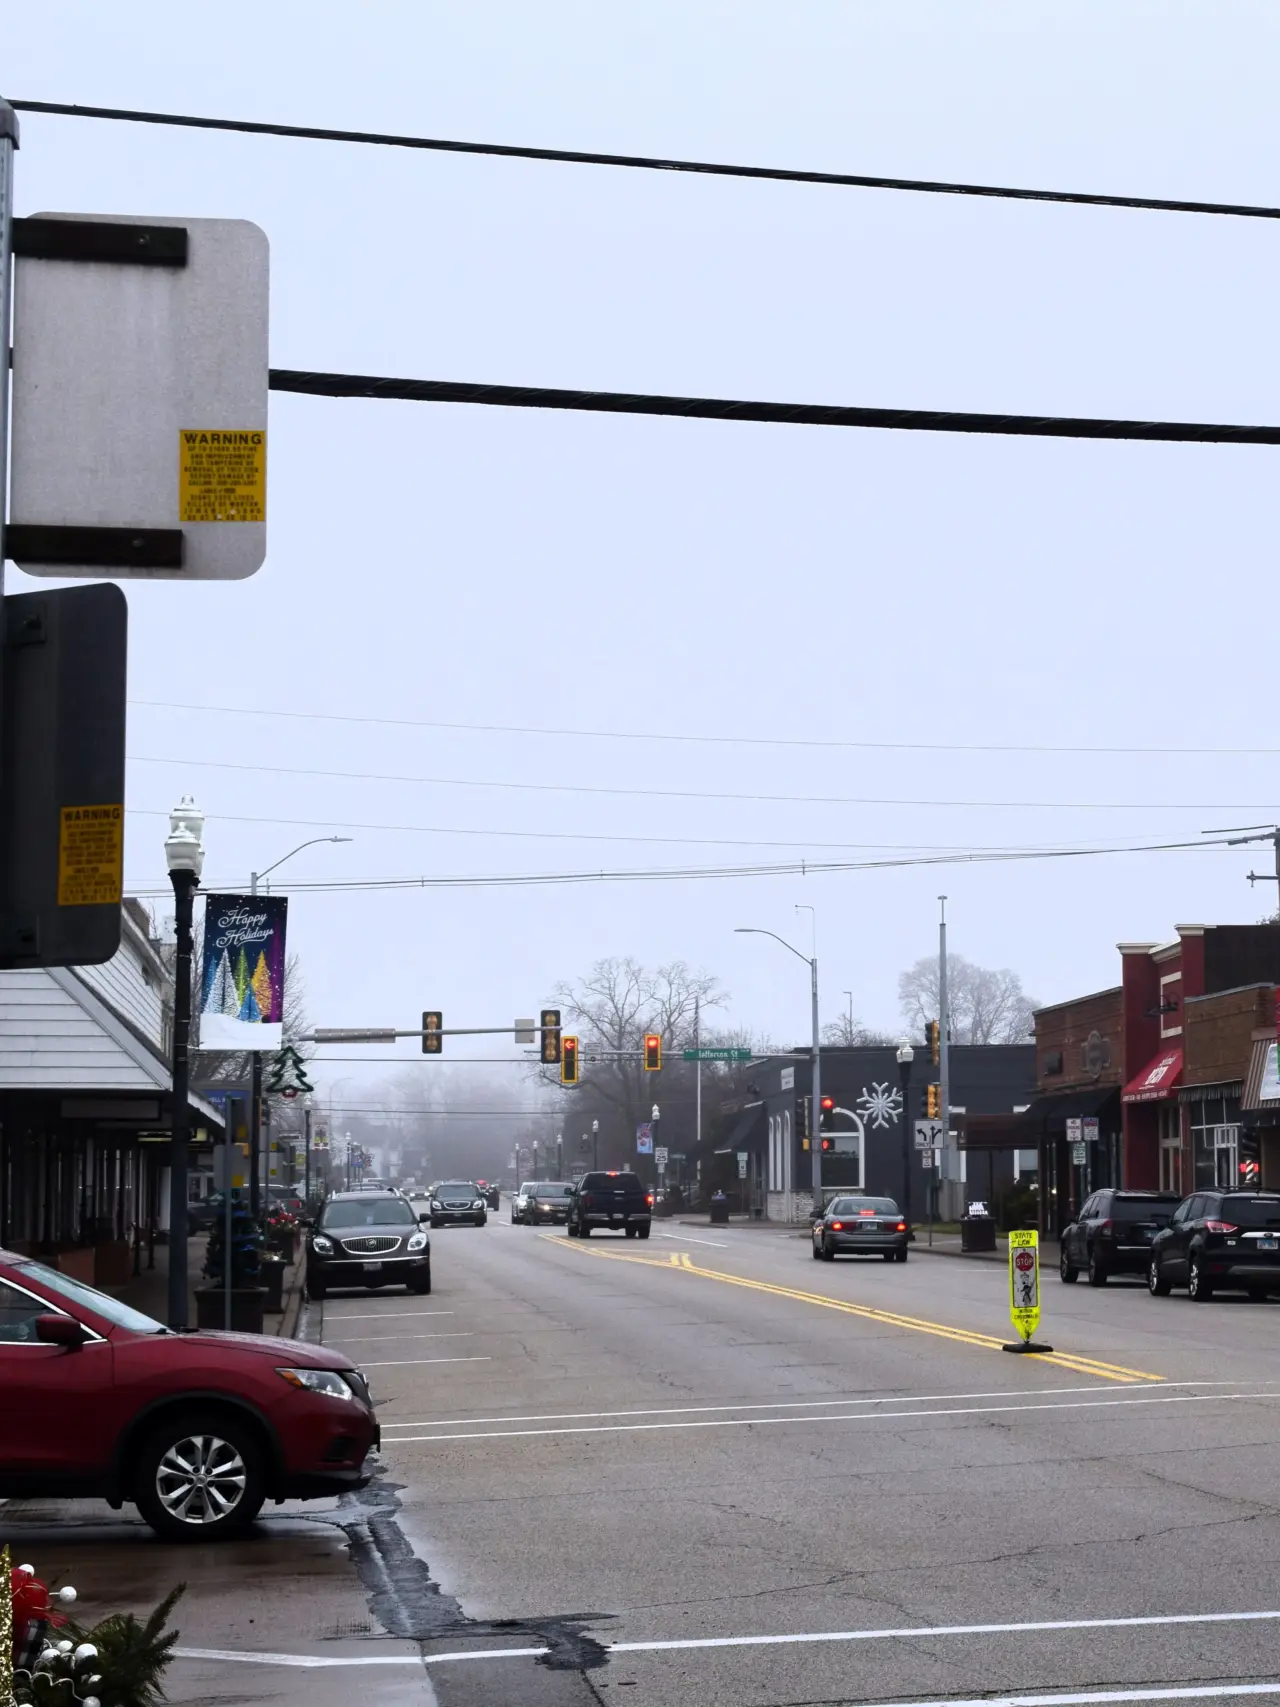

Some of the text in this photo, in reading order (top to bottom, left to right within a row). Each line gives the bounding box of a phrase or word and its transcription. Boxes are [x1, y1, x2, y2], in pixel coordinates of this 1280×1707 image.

[184, 433, 262, 445] WARNING
[64, 807, 120, 821] WARNING
[218, 907, 268, 929] Happy
[216, 928, 274, 948] Holidays
[731, 1050, 738, 1058] St
[1016, 1258, 1033, 1266] STOP
